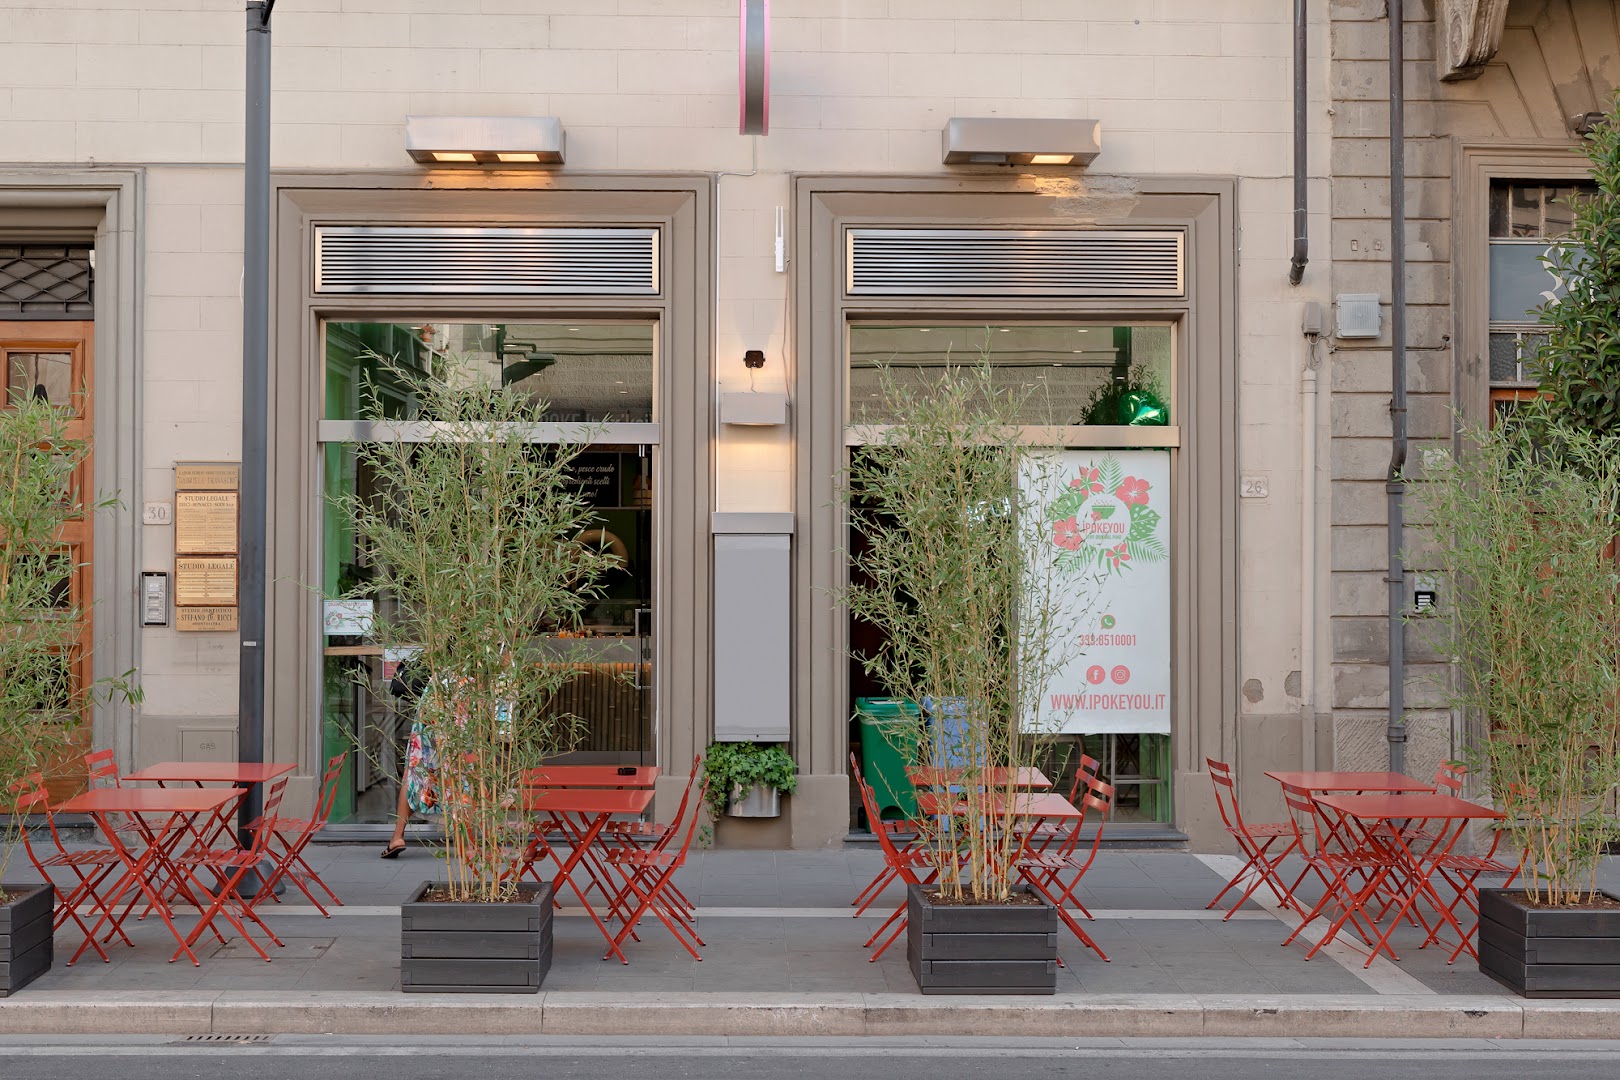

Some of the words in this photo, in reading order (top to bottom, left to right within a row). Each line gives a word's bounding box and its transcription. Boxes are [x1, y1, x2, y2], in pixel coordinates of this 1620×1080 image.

[1246, 480, 1262, 493] 26
[148, 506, 166, 520] 30
[1050, 694, 1166, 710] WWW.IPOKEYOU.IT
